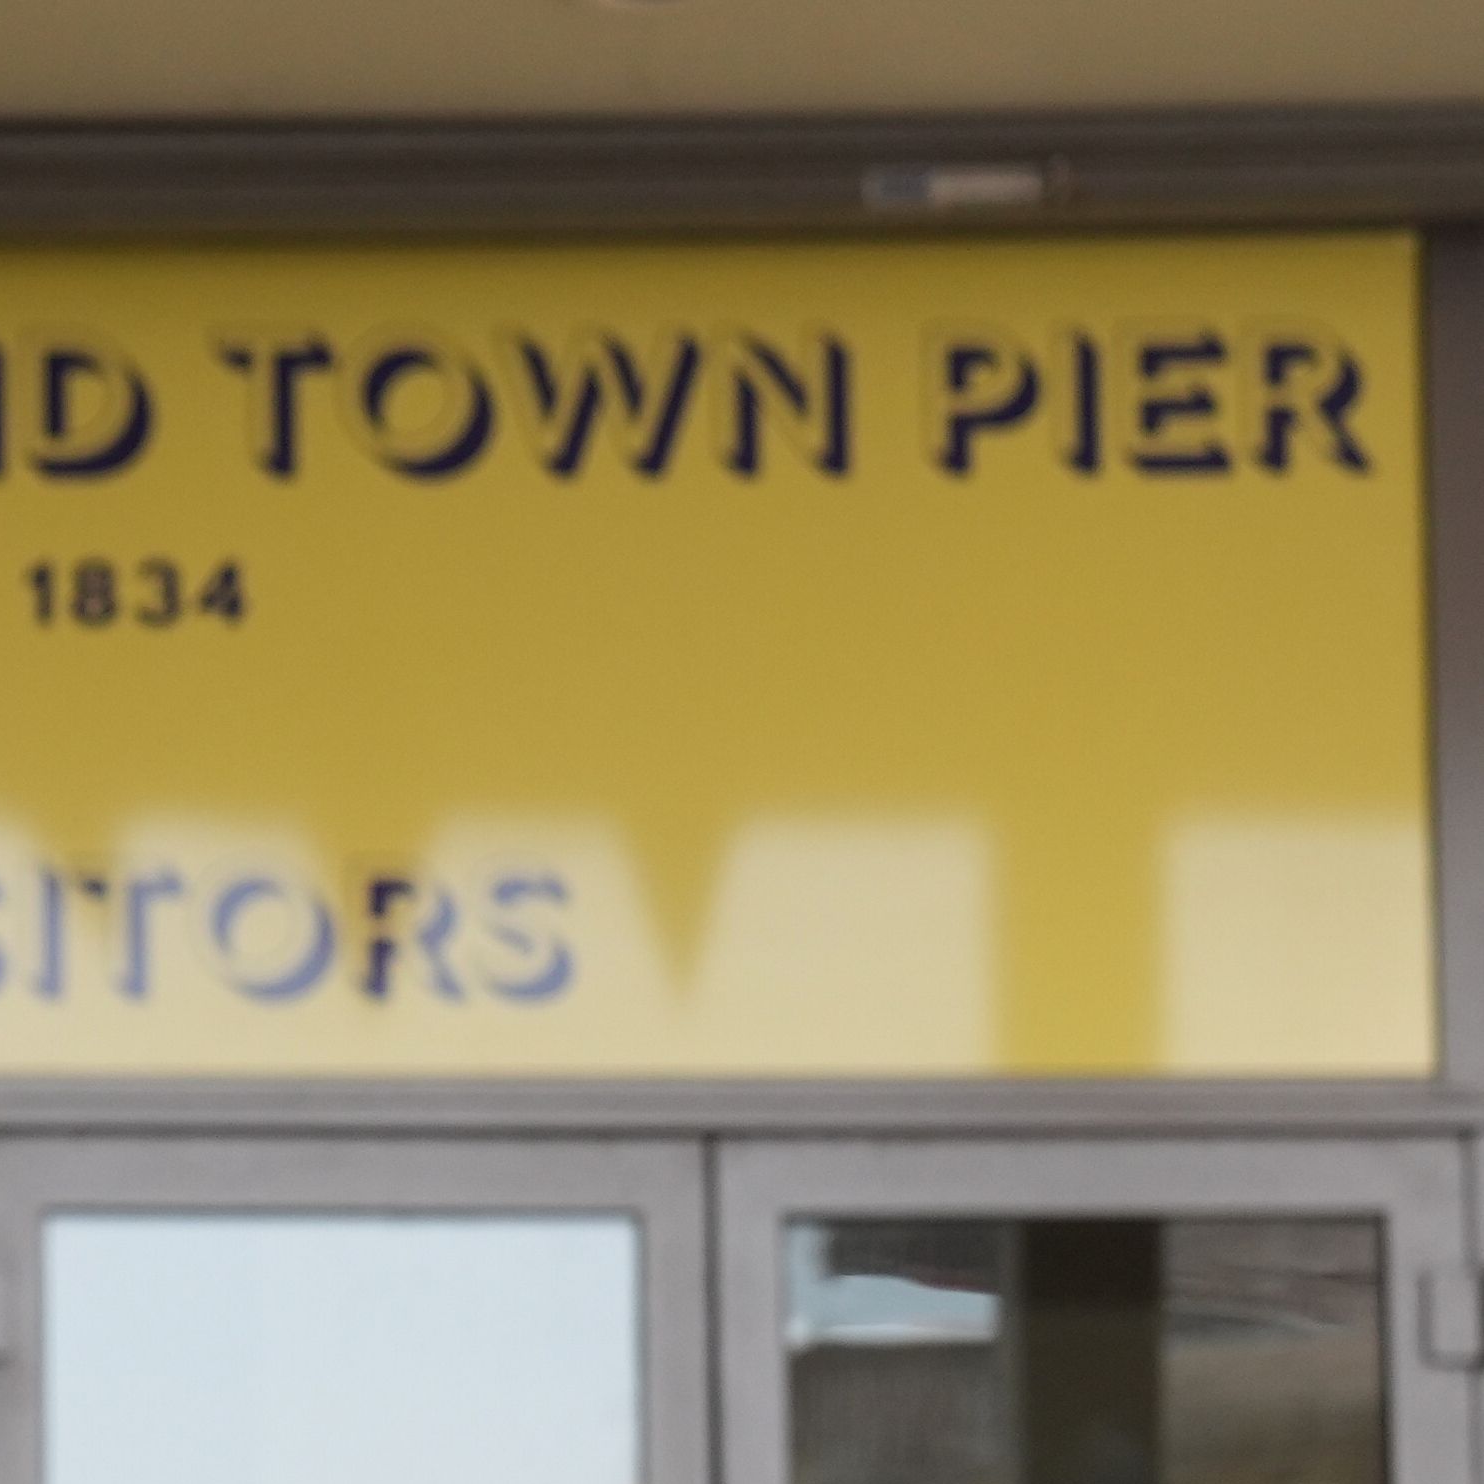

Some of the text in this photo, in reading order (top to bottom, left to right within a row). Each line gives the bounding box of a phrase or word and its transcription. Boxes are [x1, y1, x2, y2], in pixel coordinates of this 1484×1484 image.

[215, 334, 852, 484] TOWN
[936, 332, 1370, 479] PIER
[29, 562, 244, 625] 1834
